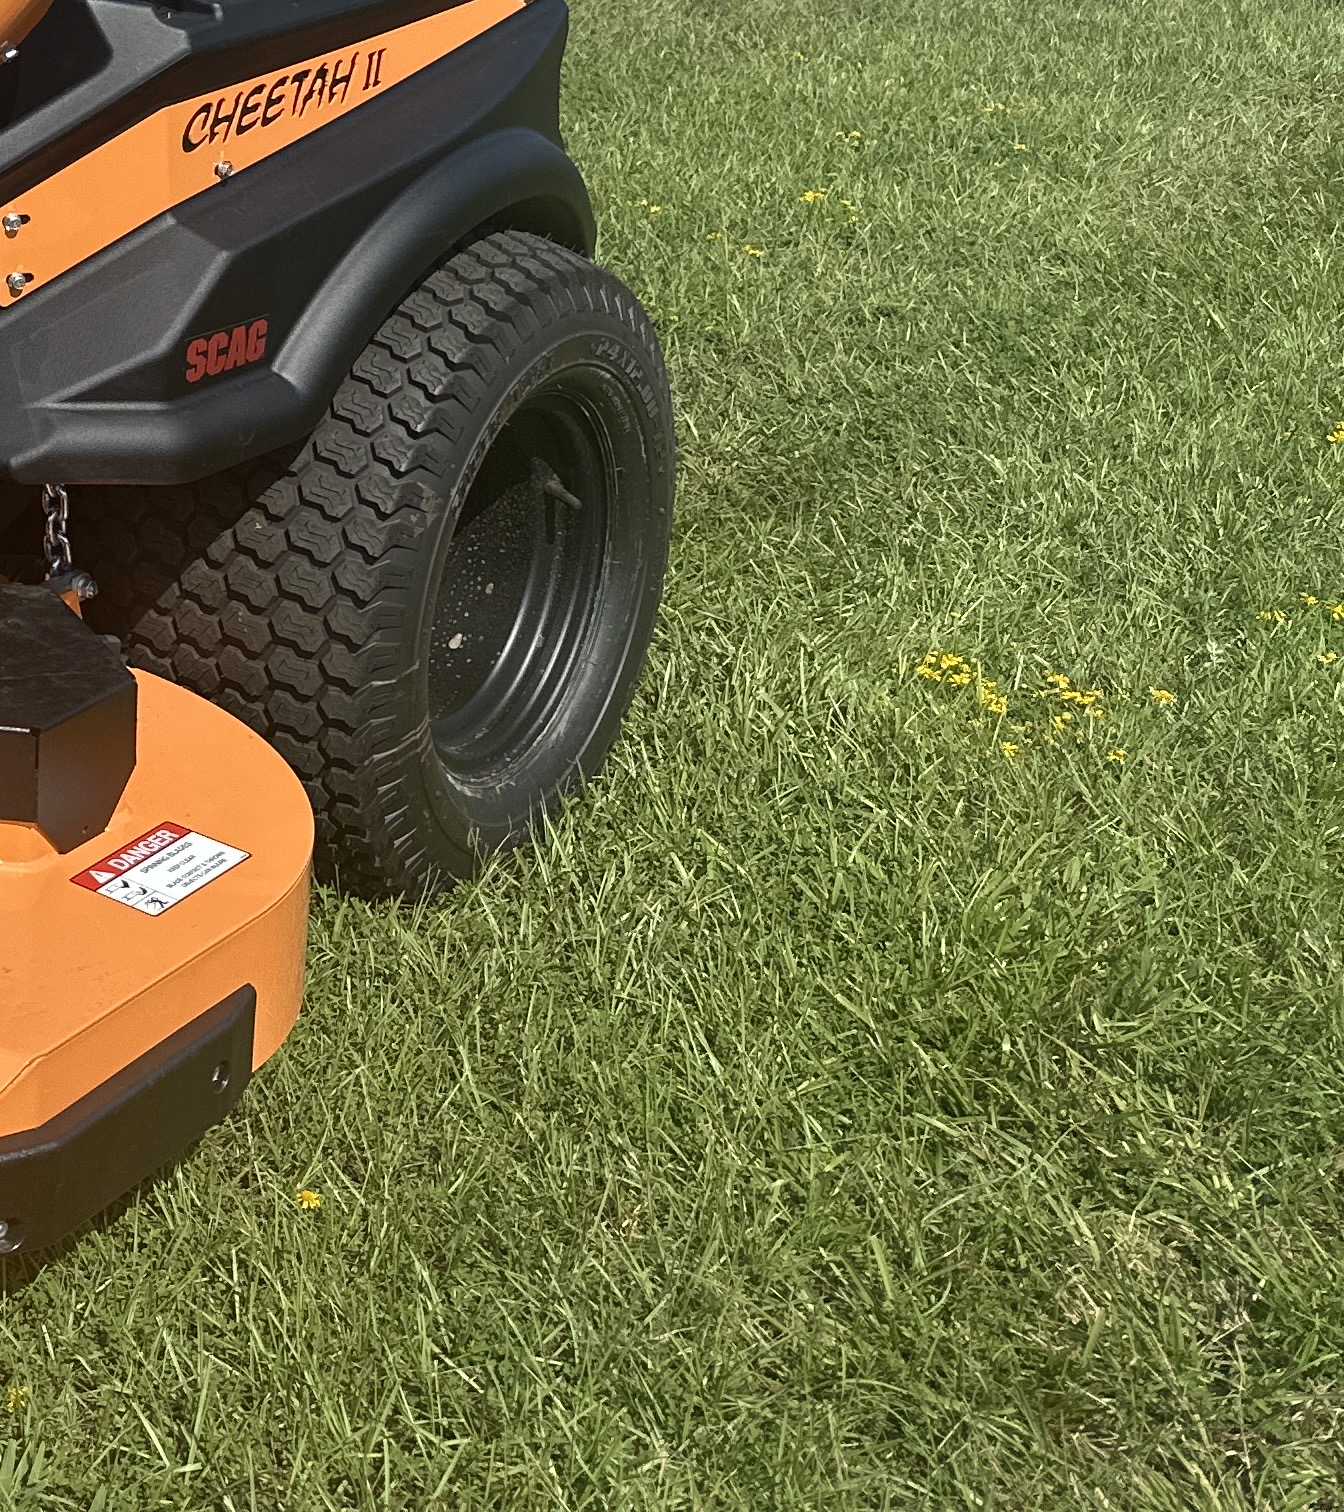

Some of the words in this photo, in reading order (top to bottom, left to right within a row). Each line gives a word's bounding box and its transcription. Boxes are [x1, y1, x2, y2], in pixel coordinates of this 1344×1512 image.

[181, 51, 360, 153] CHEETAH
[362, 48, 387, 91] II
[185, 318, 268, 383] SCAG
[107, 829, 180, 871] DANGER
